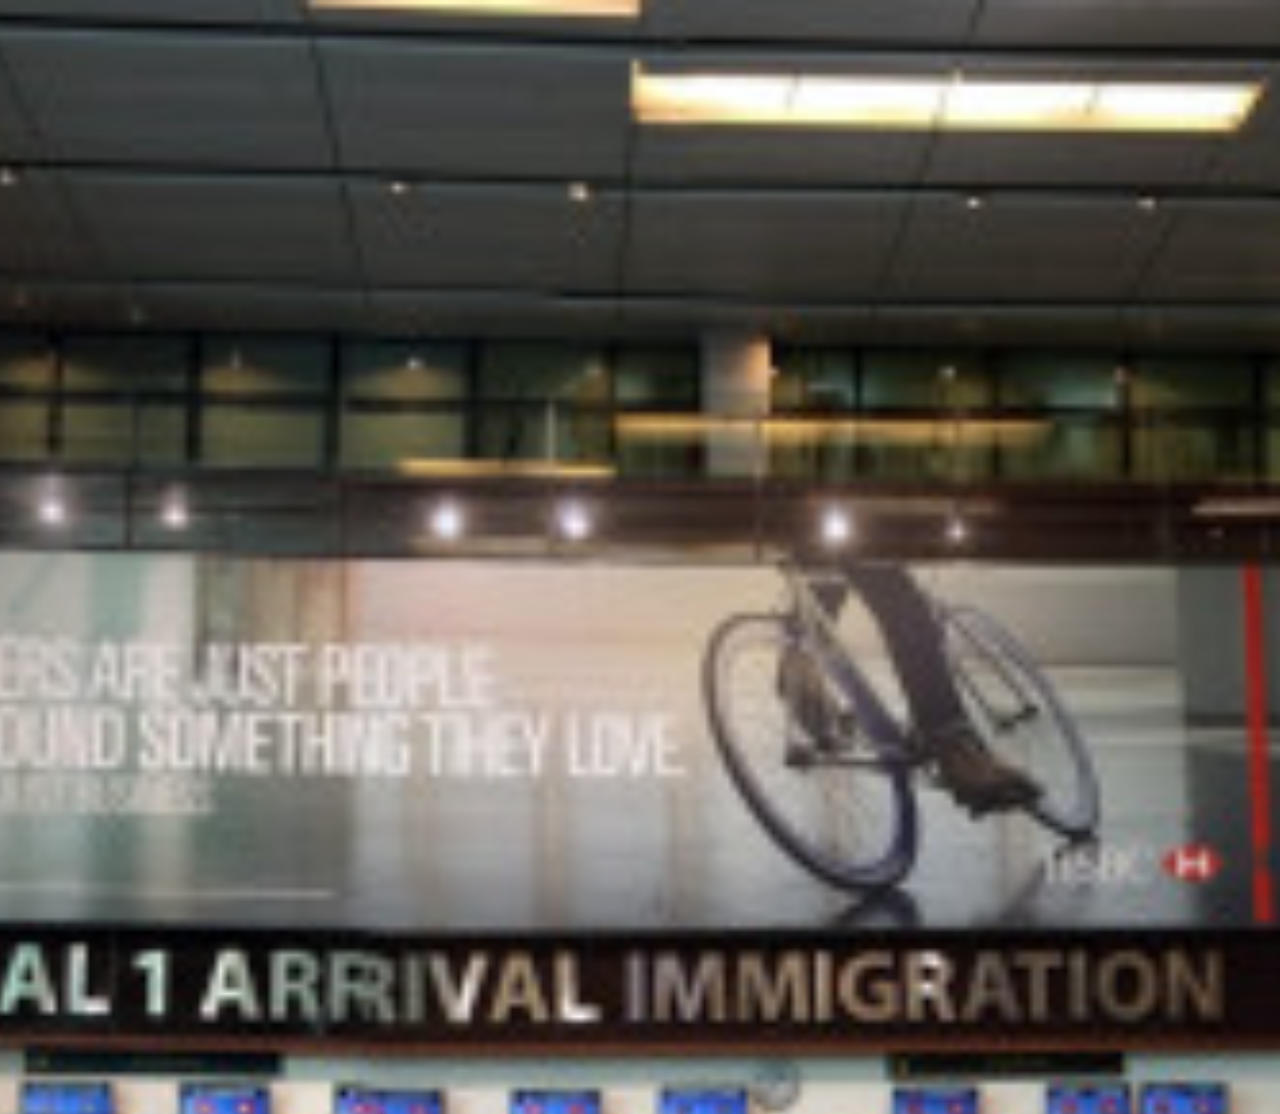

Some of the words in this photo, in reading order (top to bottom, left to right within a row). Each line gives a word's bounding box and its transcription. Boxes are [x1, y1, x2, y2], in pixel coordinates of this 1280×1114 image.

[88, 641, 182, 705] ARE
[191, 642, 309, 707] JUST
[322, 643, 498, 709] PEOPLE
[136, 707, 412, 778] SOMETHING
[131, 947, 171, 1017] 1
[197, 948, 604, 1025] ARRIVAL
[624, 946, 1226, 1024] IMMIGRATION
